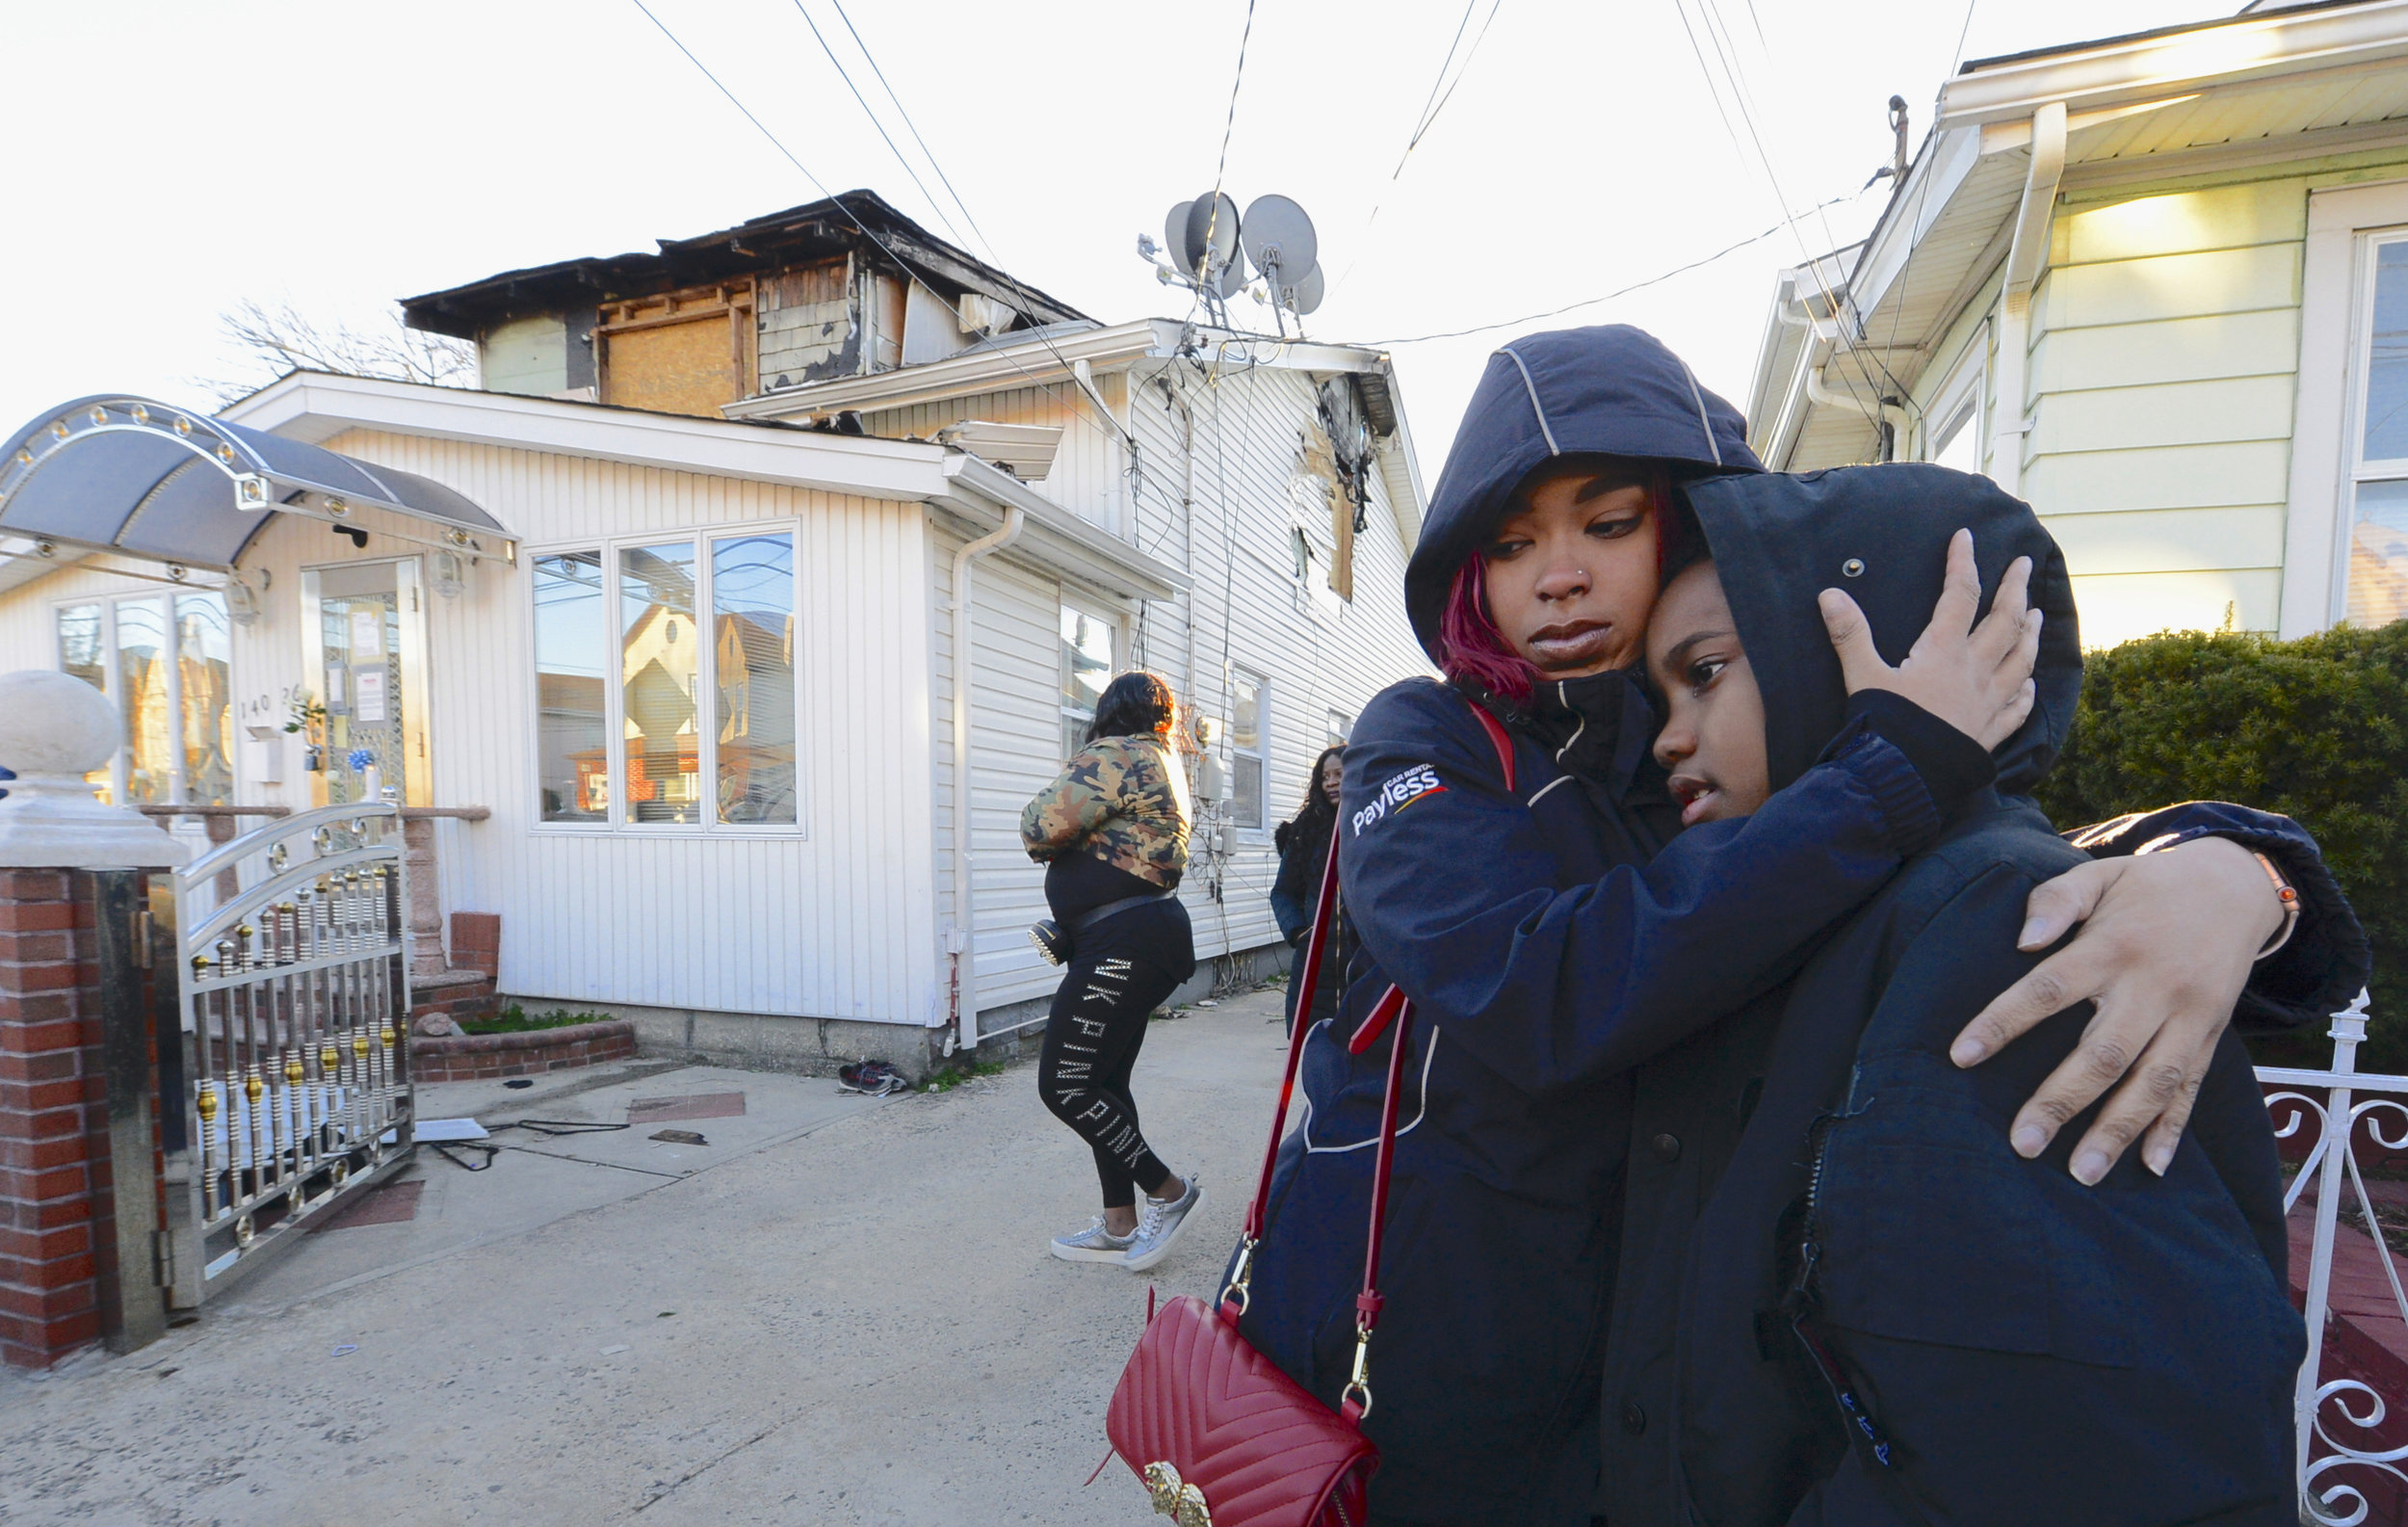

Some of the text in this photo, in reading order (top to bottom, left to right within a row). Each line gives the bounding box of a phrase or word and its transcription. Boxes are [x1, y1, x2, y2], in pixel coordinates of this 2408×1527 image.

[242, 694, 270, 719] 140
[1351, 771, 1440, 837] Payless
[1386, 763, 1435, 787] CAR RENTA
[1056, 1014, 1108, 1105] PINK
[1076, 1099, 1148, 1169] PINK
